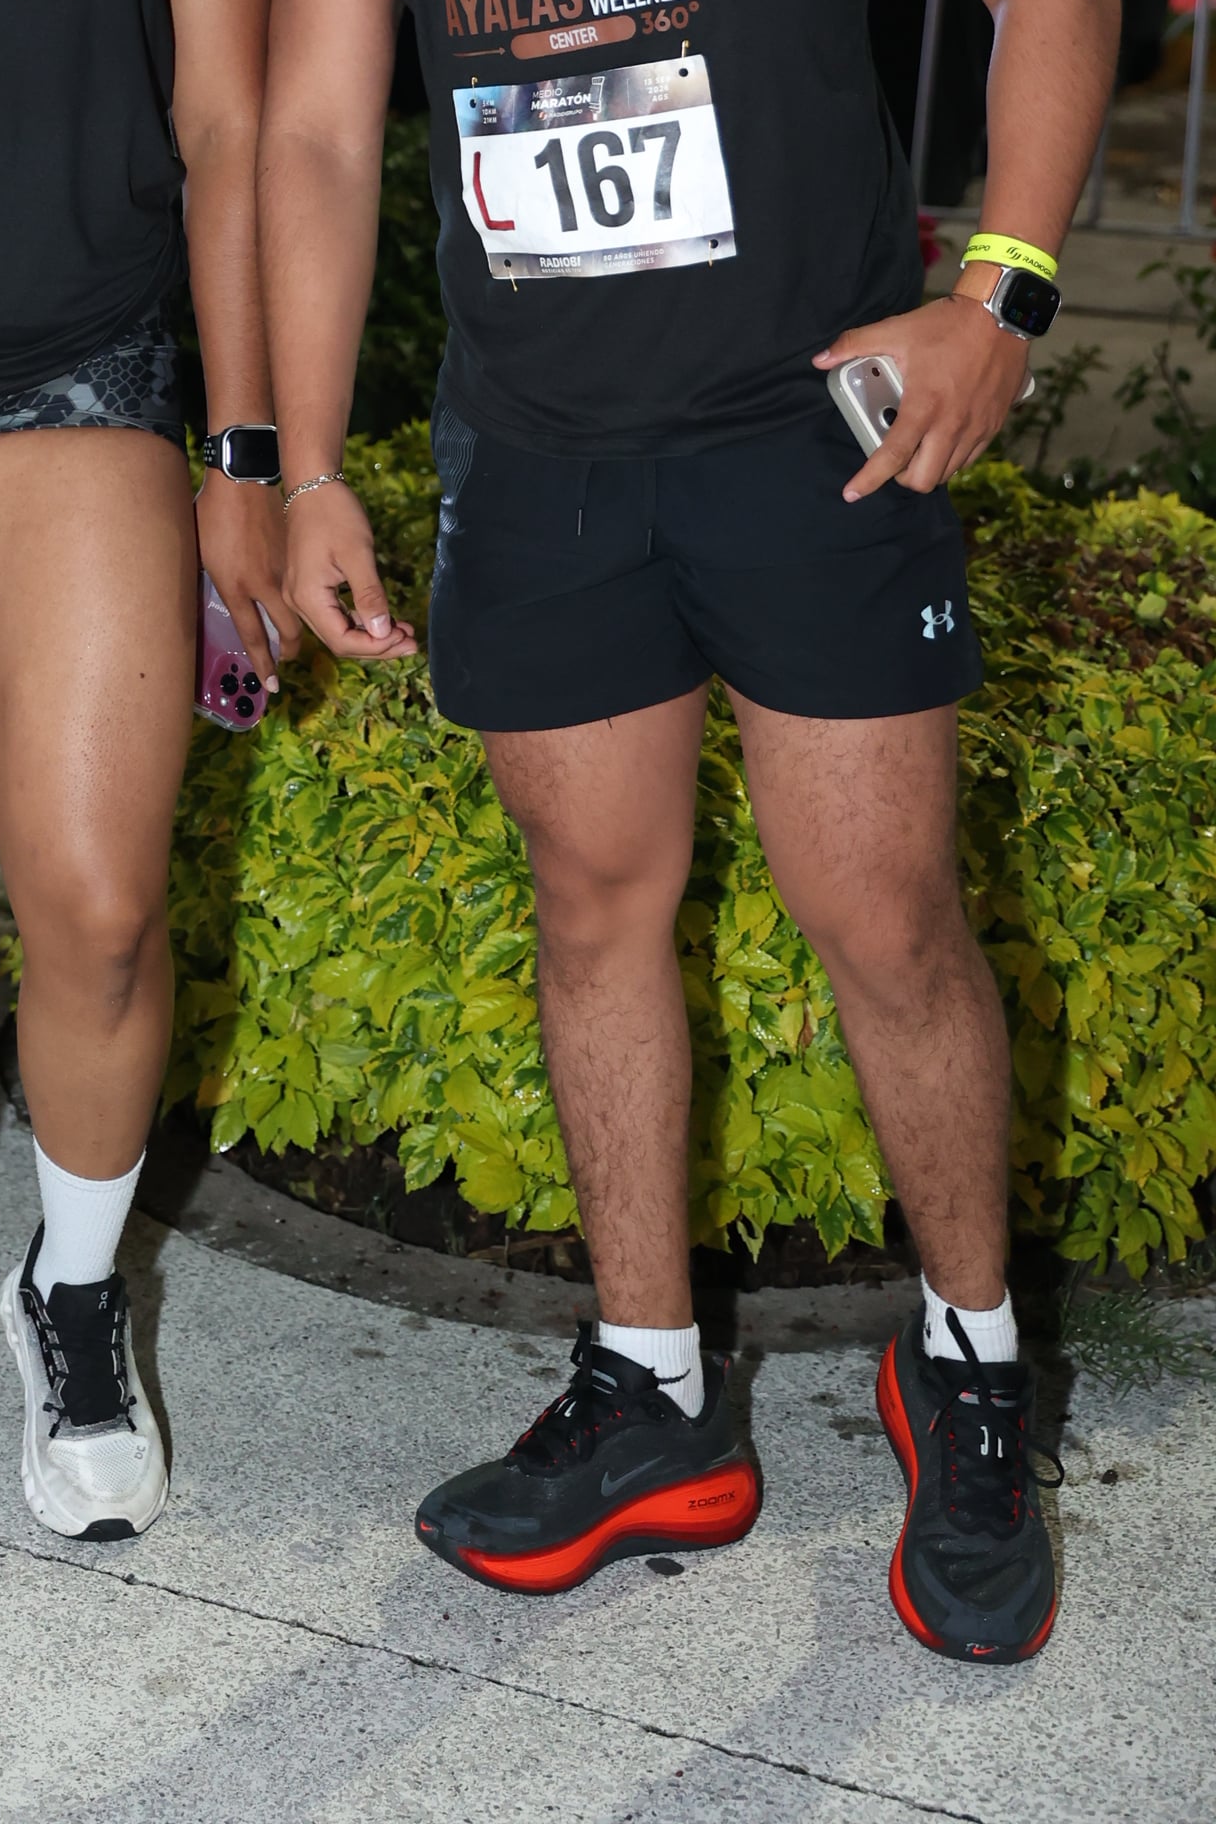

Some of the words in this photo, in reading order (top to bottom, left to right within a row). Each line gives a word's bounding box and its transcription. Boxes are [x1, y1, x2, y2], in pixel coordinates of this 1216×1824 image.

[548, 26, 598, 50] CENTER
[531, 91, 592, 111] MARATÓN
[533, 87, 563, 99] MEDIO
[652, 93, 669, 102] AGS
[534, 119, 682, 233] 167
[539, 255, 581, 268] RADIOBI
